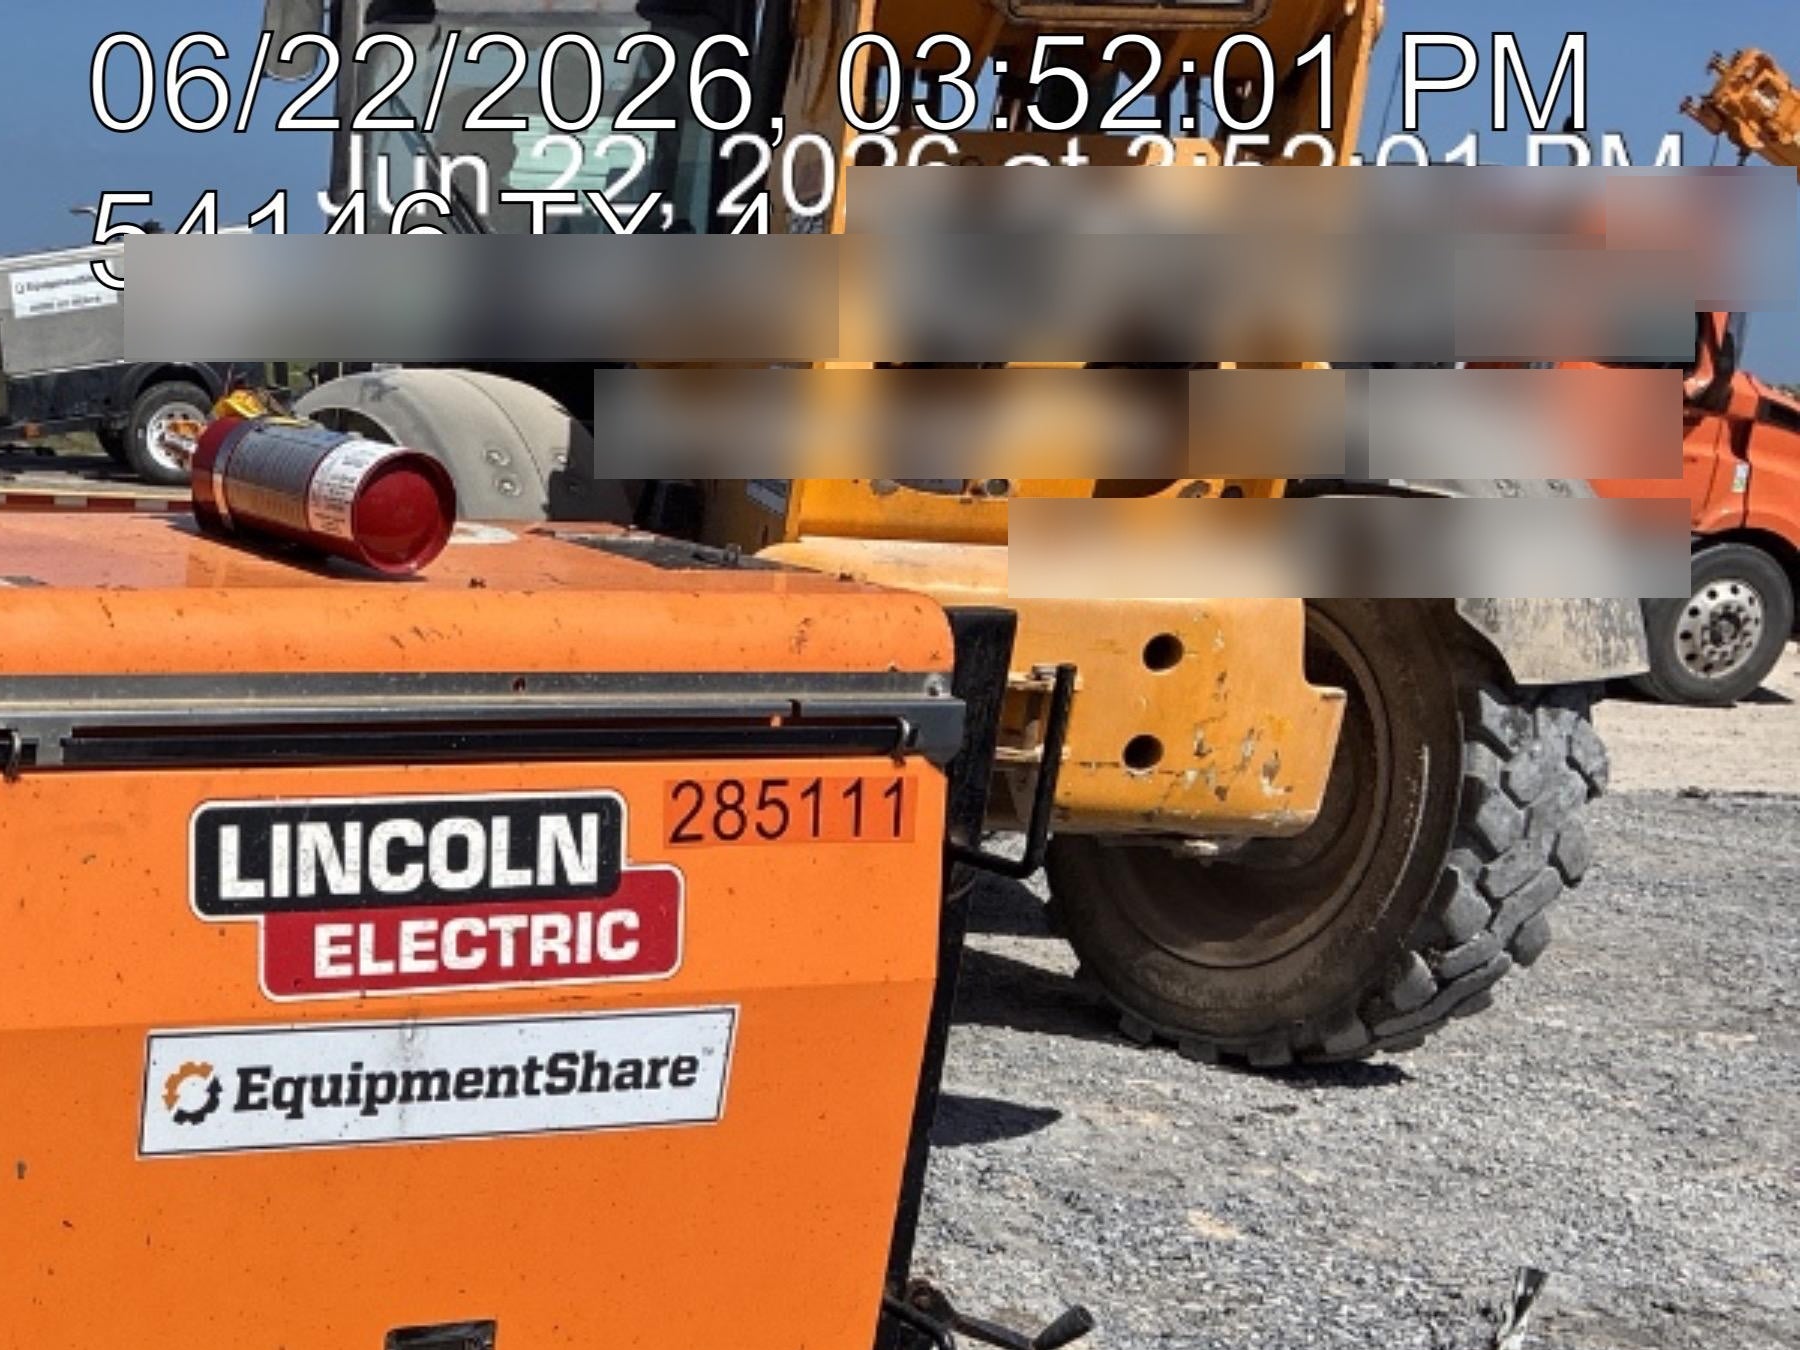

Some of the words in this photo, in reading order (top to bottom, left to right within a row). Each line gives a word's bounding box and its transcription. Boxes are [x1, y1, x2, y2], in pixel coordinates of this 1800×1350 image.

[669, 777, 904, 844] 285111
[218, 813, 599, 900] LINCOLN
[314, 909, 640, 979] ELECTRIC
[233, 1050, 700, 1120] EquipmentShare
